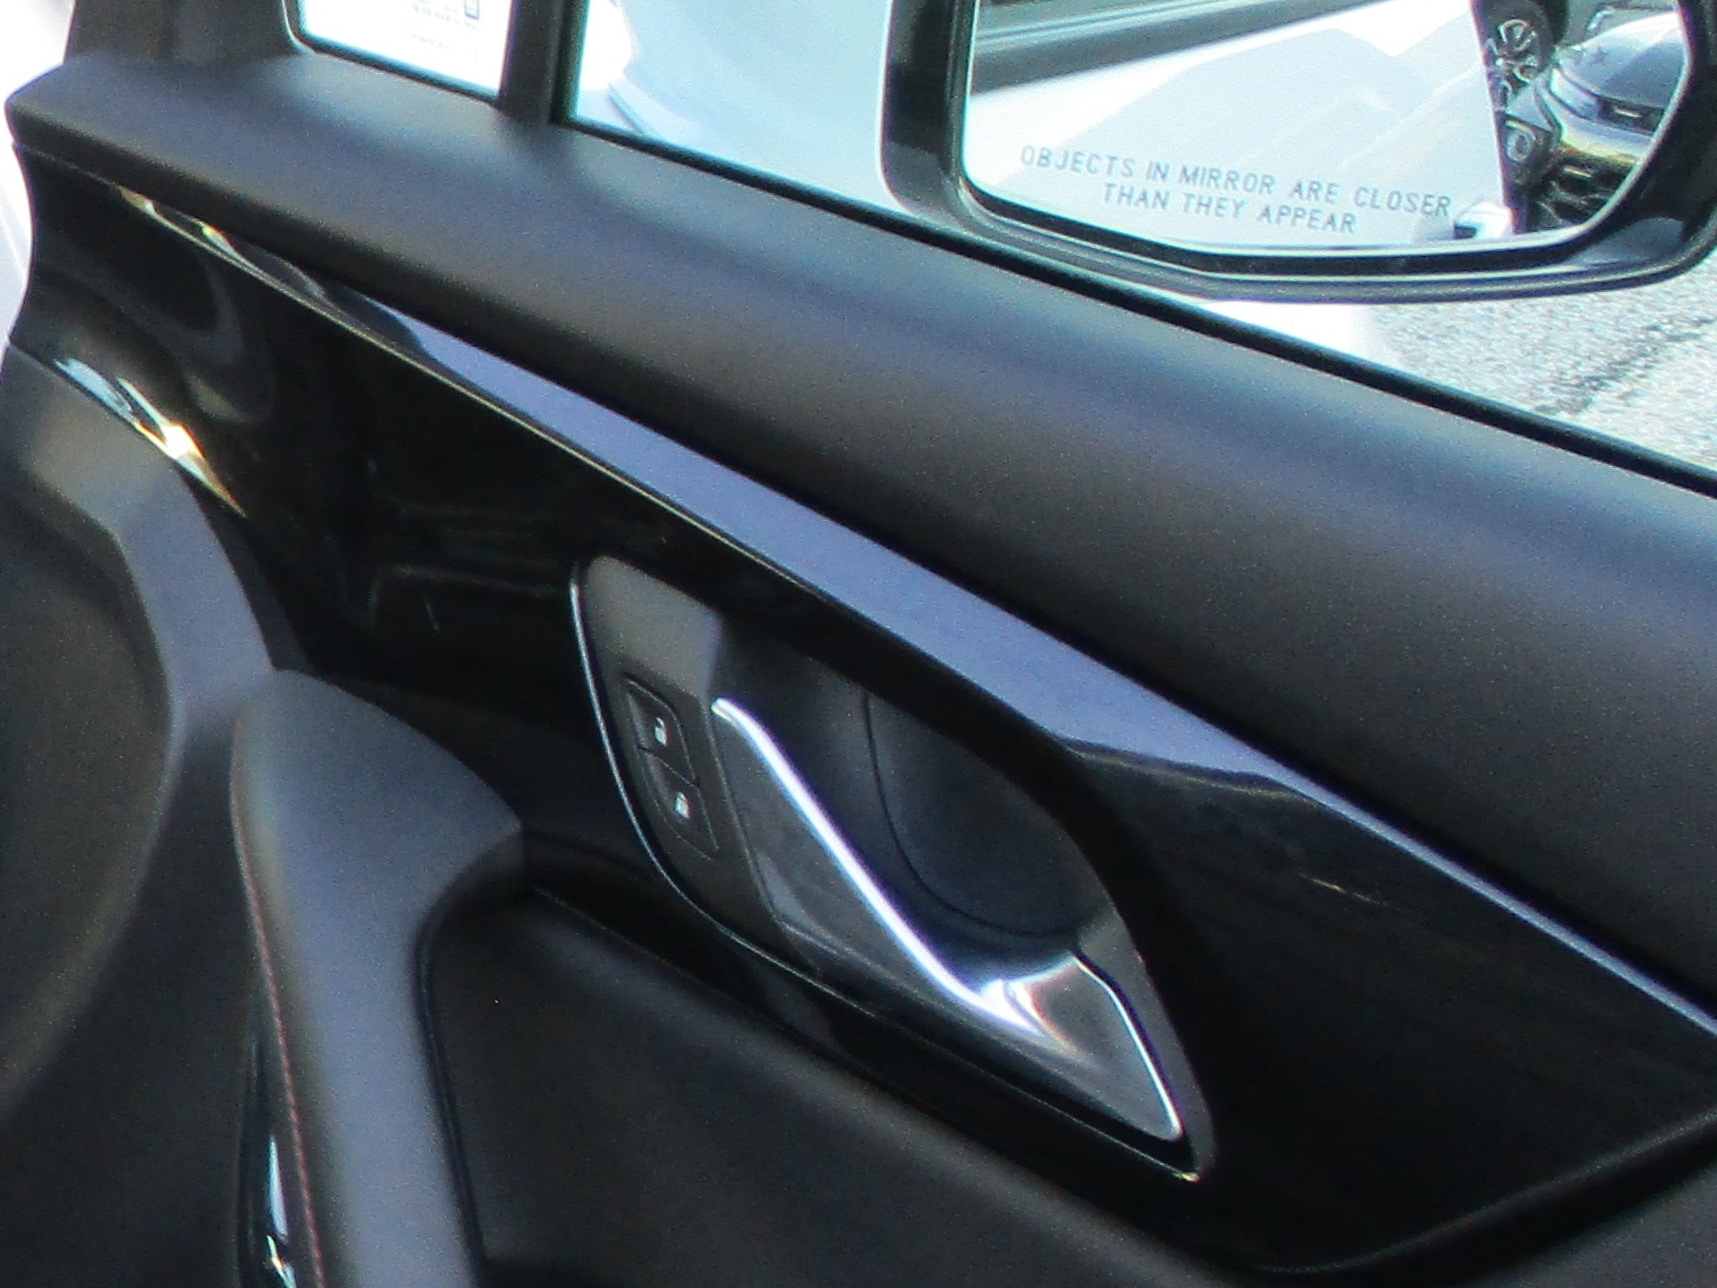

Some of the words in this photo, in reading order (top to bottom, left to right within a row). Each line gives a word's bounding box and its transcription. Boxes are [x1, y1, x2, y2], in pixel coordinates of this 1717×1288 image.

[1020, 145, 1136, 179] OBJECTS
[1145, 160, 1170, 183] IN
[1178, 163, 1276, 196] MIRROR
[1288, 180, 1341, 205] ARE
[1354, 185, 1452, 217] CLOSER
[1102, 182, 1170, 210] THAN
[1182, 192, 1248, 220] THEY
[1256, 204, 1357, 235] APPEAR
